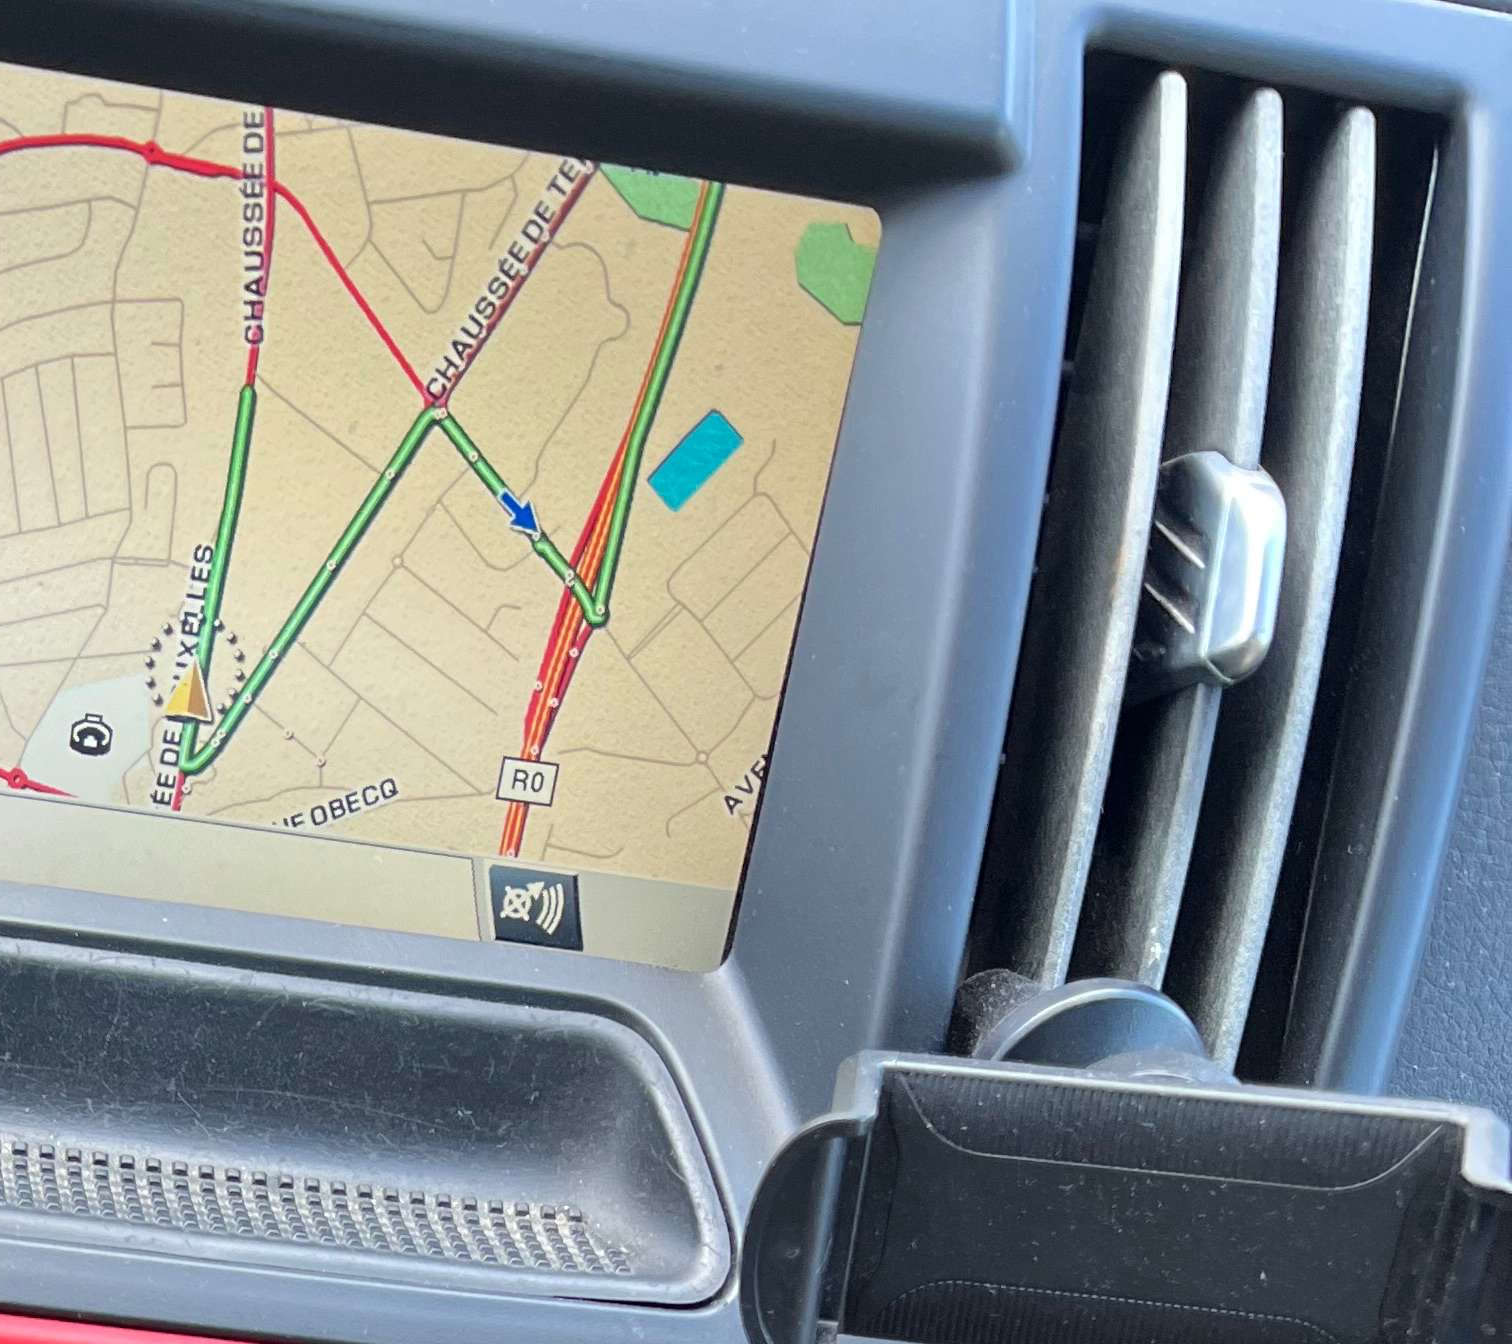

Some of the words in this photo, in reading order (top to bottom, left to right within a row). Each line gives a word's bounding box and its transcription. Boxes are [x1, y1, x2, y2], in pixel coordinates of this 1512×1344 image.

[243, 111, 265, 153] DE
[239, 163, 264, 345] CHAUSSÉE
[426, 241, 530, 401] CHAUSSÉE
[521, 200, 556, 245] DE
[162, 729, 183, 767] DE
[310, 778, 399, 826] OBECQ
